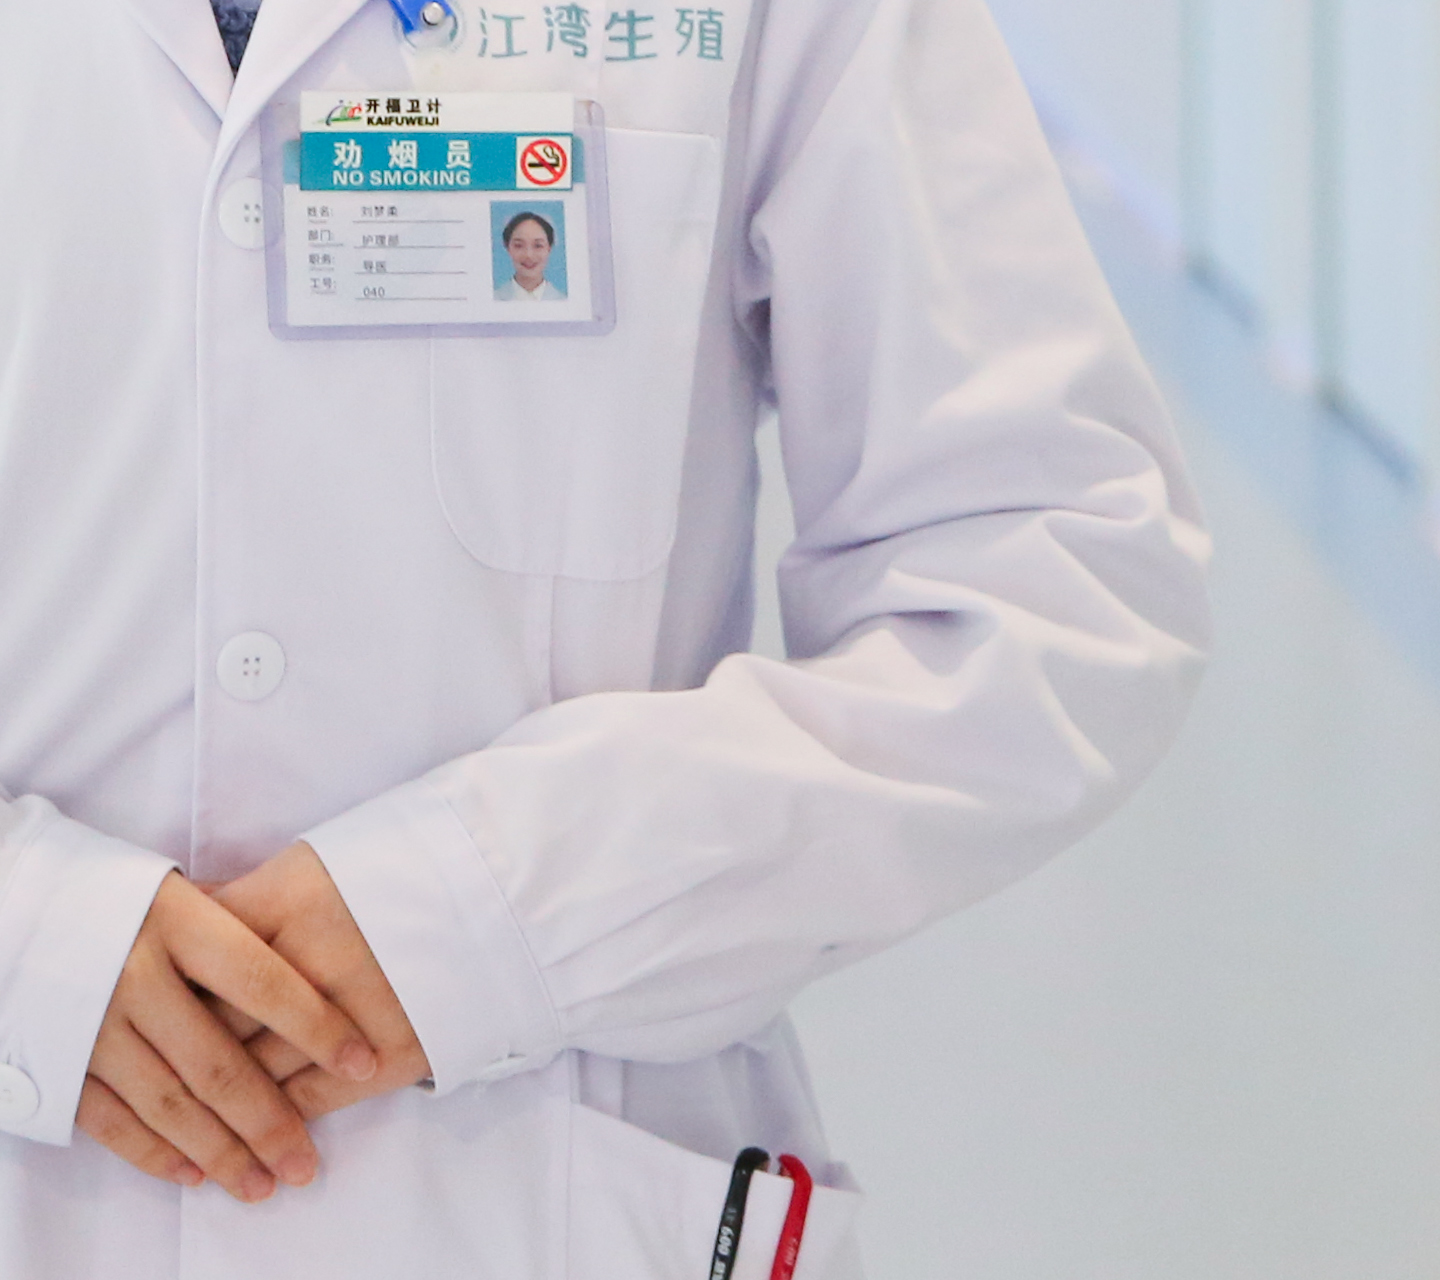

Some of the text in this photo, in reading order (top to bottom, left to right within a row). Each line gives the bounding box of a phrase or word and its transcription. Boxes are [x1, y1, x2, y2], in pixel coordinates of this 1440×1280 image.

[477, 2, 724, 62] 江湾生殖
[365, 98, 442, 114] 开福卫计
[367, 116, 440, 126] KAIFUWEIJI
[333, 139, 472, 169] 劝烟员
[333, 170, 470, 185] NO SMOKING
